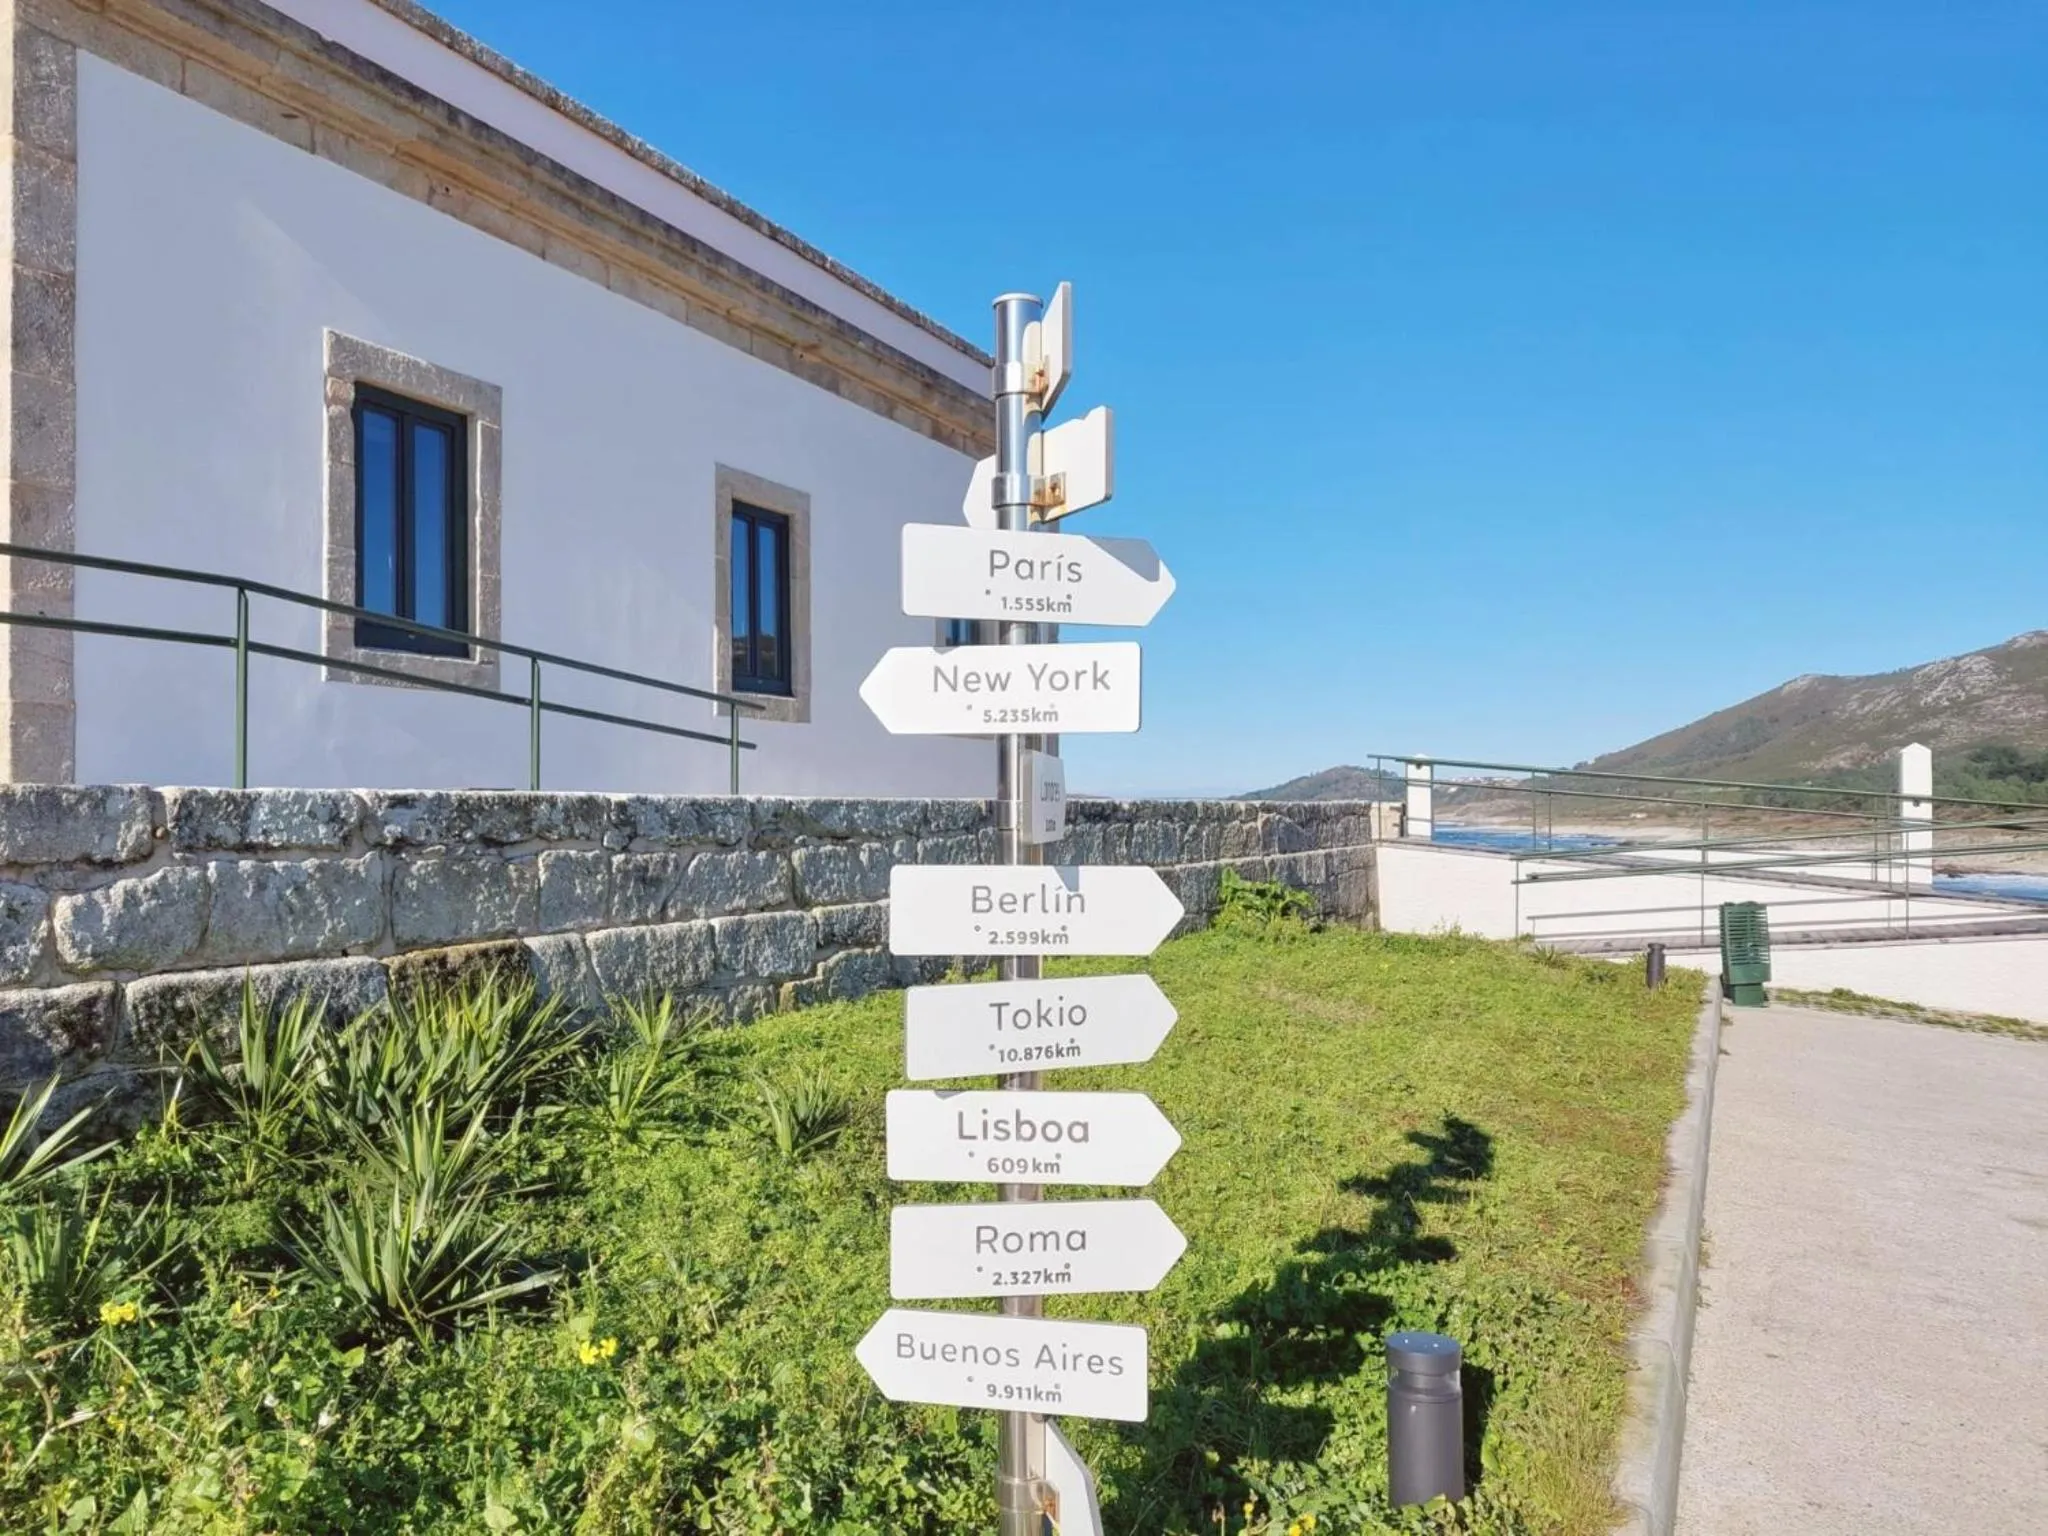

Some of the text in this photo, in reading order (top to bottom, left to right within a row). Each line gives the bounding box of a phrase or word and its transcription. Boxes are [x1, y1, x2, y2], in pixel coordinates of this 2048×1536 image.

[989, 549, 1083, 584] París
[1001, 596, 1073, 613] 1.555km
[932, 660, 1111, 694] New York
[982, 706, 1059, 724] 5.235km
[971, 883, 1086, 915] Berlín
[988, 928, 1069, 945] 2.599km
[988, 995, 1088, 1032] Tokio
[998, 1042, 1082, 1063] 10.876km
[957, 1108, 1090, 1144] Lisboa
[975, 1224, 1087, 1255] Roma
[992, 1269, 1072, 1286] 2.327km
[896, 1332, 1124, 1377] Buenos Aires
[986, 1382, 1062, 1403] 9.911km
